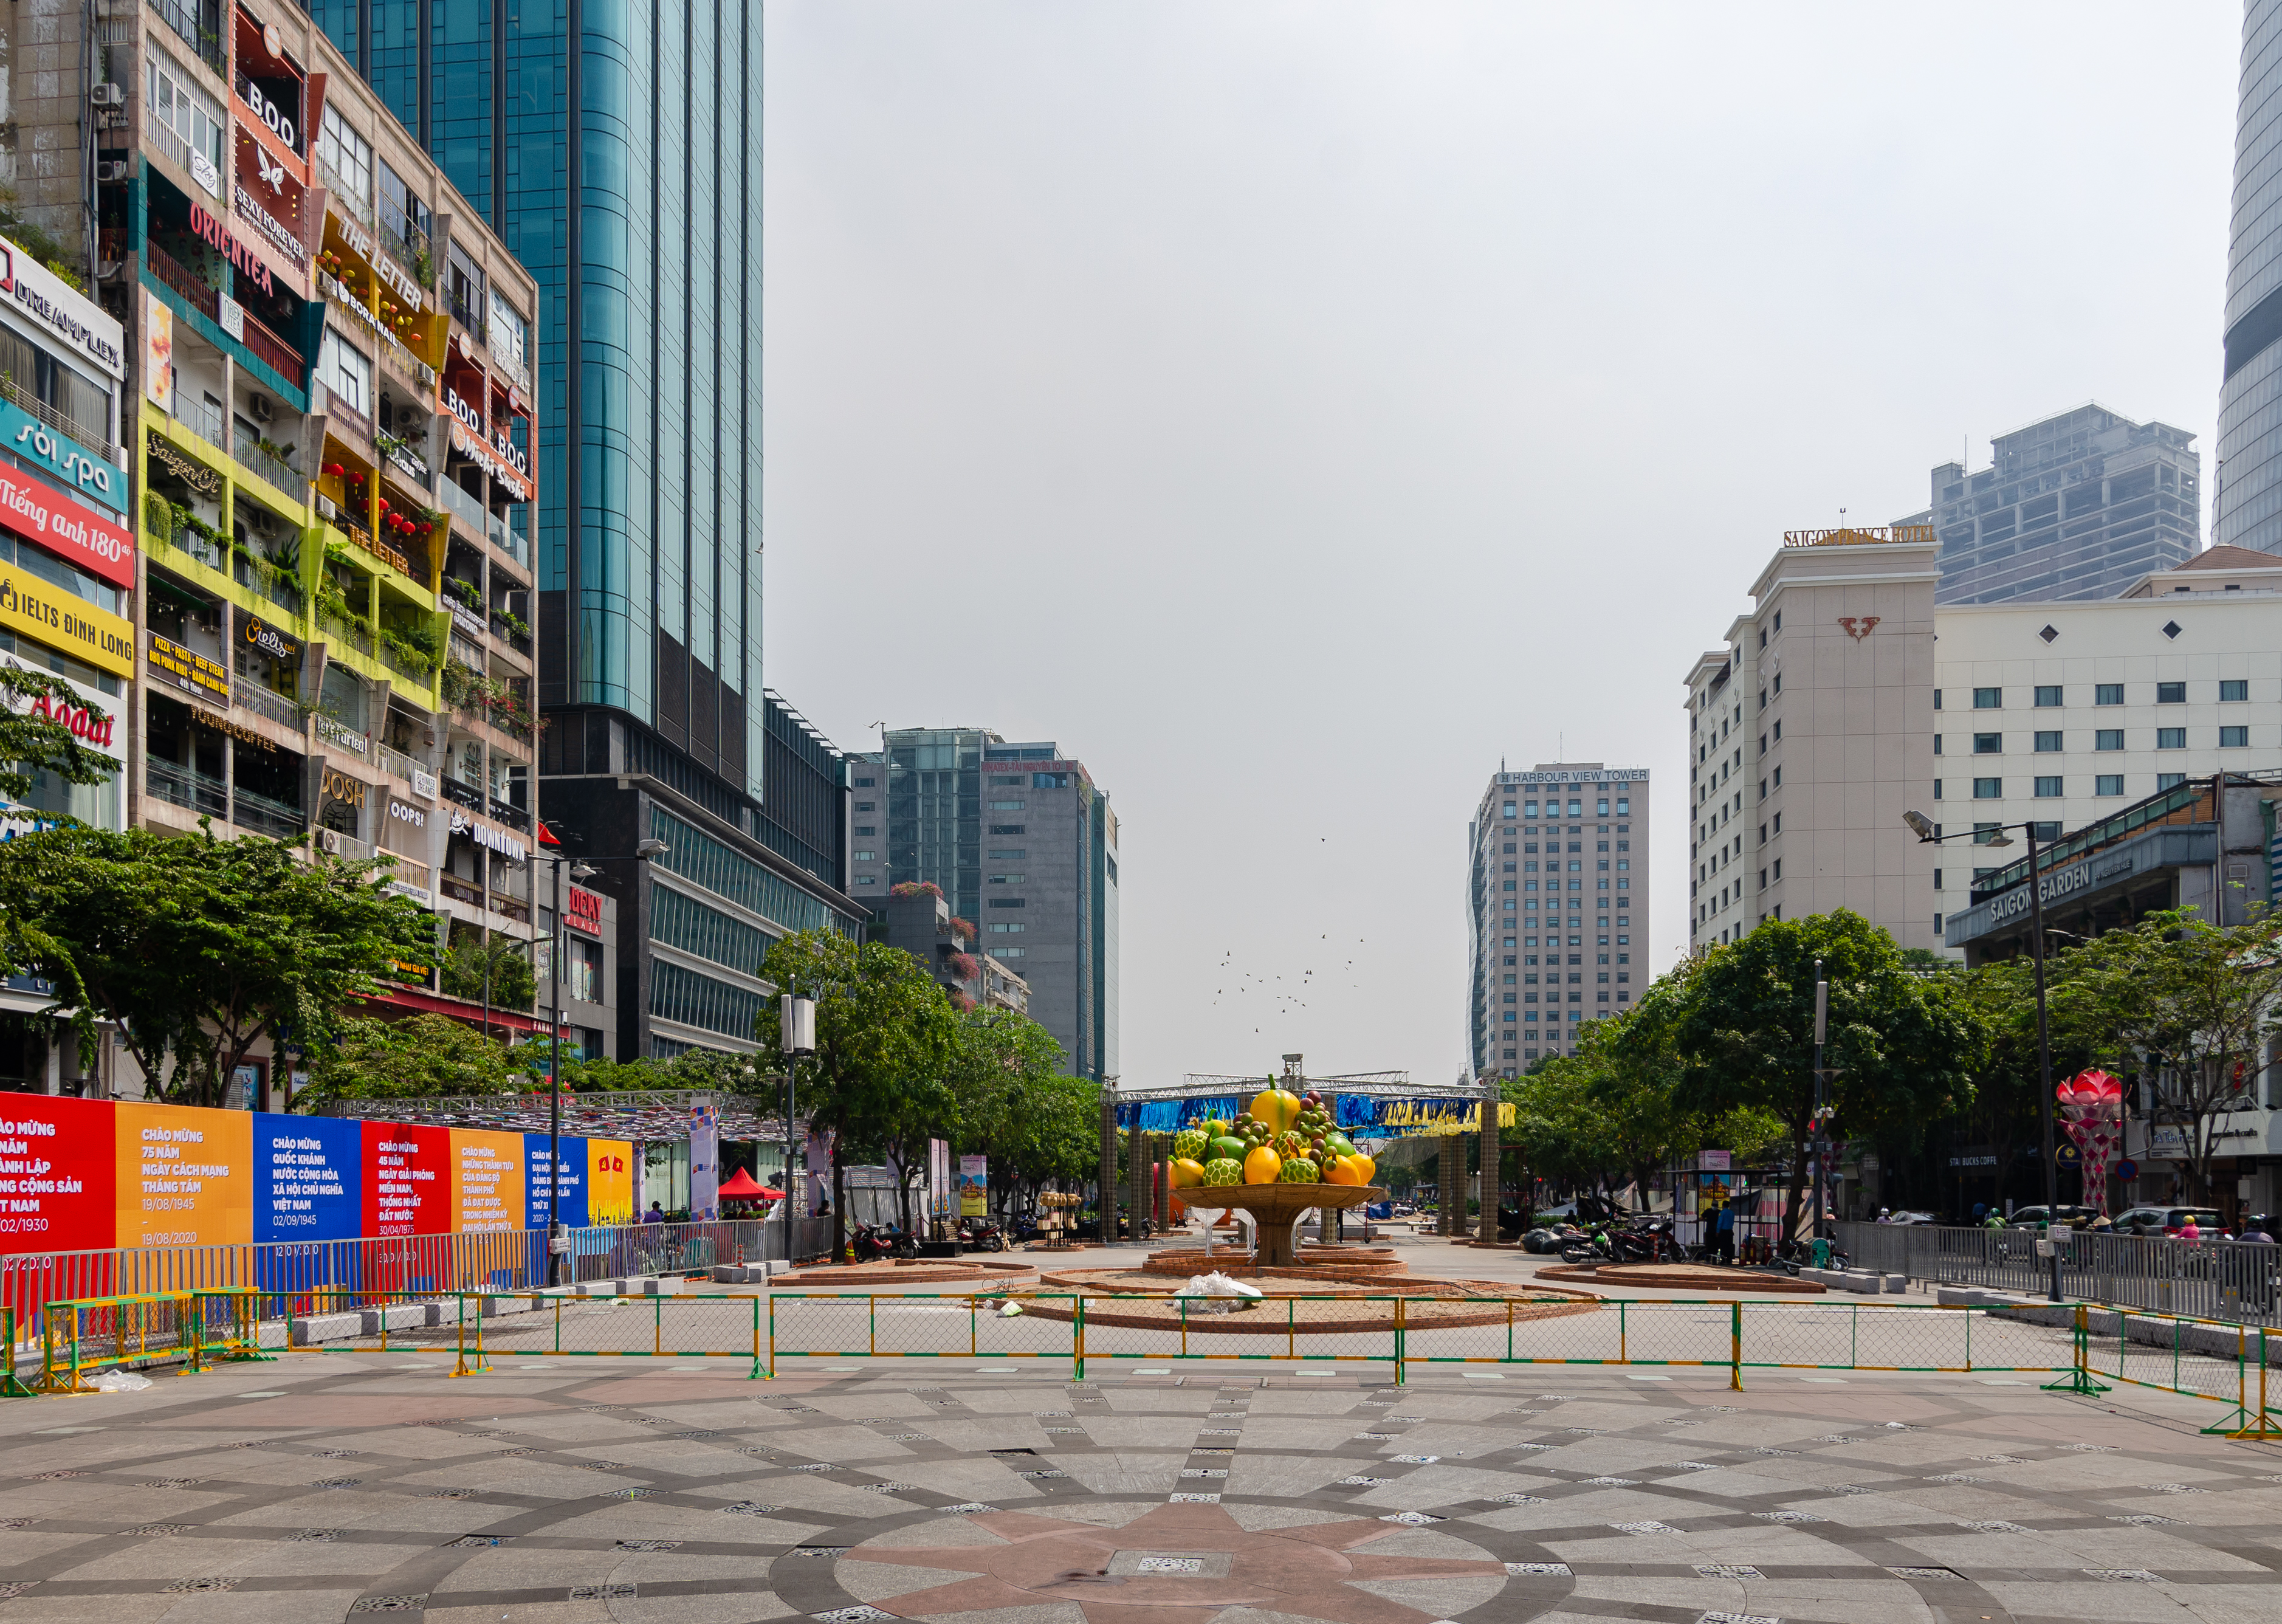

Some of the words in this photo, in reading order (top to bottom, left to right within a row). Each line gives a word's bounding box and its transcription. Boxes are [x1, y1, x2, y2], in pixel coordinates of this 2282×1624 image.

[250, 82, 294, 148] BOO
[194, 156, 216, 188] Sky
[236, 186, 262, 217] SEXY
[263, 210, 305, 261] FOREVER
[190, 202, 273, 297] ORIENTEA
[340, 214, 369, 263] THE
[371, 247, 422, 313] LETTER
[15, 279, 120, 368] DREAMPLEX
[350, 295, 376, 328] BORA
[377, 320, 397, 347] NAIL
[449, 388, 478, 432] BOO
[498, 433, 526, 474] BOO
[63, 452, 109, 492] spa
[465, 436, 494, 477] Michi
[497, 464, 524, 501] Sushi
[0, 478, 47, 531] Tiếng
[90, 528, 121, 563] 180
[1784, 529, 1834, 547] SAIGON
[1838, 528, 1888, 545] PRINCE
[1892, 525, 1937, 543] HOTEL
[348, 523, 371, 551] THE
[371, 538, 409, 577] LETTER
[22, 593, 58, 628] IELTS
[64, 613, 96, 645] ĐÌNH
[101, 630, 132, 661] LONG
[155, 636, 170, 653] PIZZA
[175, 646, 191, 663] PASTA
[196, 656, 208, 670] BEEF
[208, 662, 224, 678] STEAK
[149, 650, 160, 666] BBQ
[161, 655, 175, 672] PORK
[176, 662, 188, 677] RIBS
[192, 669, 205, 685] BÁNH
[206, 676, 219, 692] CANH
[179, 678, 189, 689] 4th
[190, 682, 202, 695] floor
[191, 704, 232, 735] YOUNG
[234, 724, 277, 752] COFFEE
[1051, 762, 1073, 771] TOER
[1513, 772, 1569, 782] HARBOUR
[1573, 771, 1601, 780] VIEW
[1605, 771, 1647, 780] TOWER
[391, 802, 424, 827] OOPS!
[1991, 890, 2032, 921] SAIGON
[2039, 863, 2089, 902] GARDEN
[569, 886, 602, 921] UCKY
[566, 915, 599, 935] PLAZA
[17, 1119, 55, 1136] MỪNG
[142, 1127, 171, 1142] CHÀO
[173, 1128, 204, 1143] MỪNG
[142, 1147, 154, 1158] 75
[156, 1144, 180, 1159] NĂM
[273, 1136, 296, 1149] CHÀO
[297, 1137, 321, 1151] MỪNG
[379, 1140, 397, 1152] CHÀO
[399, 1141, 419, 1153] MỪNG
[273, 1150, 297, 1165] QUỐC
[298, 1152, 326, 1165] KHÁNH
[379, 1156, 388, 1166] 45
[388, 1154, 404, 1166] NĂM
[462, 1146, 478, 1157] CHÀO
[479, 1147, 495, 1158] MỪNG
[532, 1149, 545, 1160] CHÀO
[26, 1158, 51, 1177] LẬP
[462, 1159, 483, 1169] NHỮNG
[484, 1160, 502, 1170] THÀNH
[1950, 1157, 1979, 1166] STABUCKS
[142, 1161, 171, 1176] NGÀY
[173, 1161, 201, 1177] CÁCH
[202, 1165, 229, 1179] MẠNG
[273, 1167, 297, 1180] NƯỚC
[298, 1167, 321, 1182] CỘNG
[322, 1168, 339, 1180] HÒA
[379, 1168, 397, 1180] NGÀY
[399, 1167, 412, 1180] GIẢI
[413, 1169, 435, 1180] PHÓNG
[462, 1171, 475, 1182] CỦA
[476, 1171, 492, 1182] ĐẢNG
[493, 1172, 500, 1184] BỘ
[19, 1177, 55, 1196] CỘNG
[57, 1175, 82, 1193] SẢN
[142, 1180, 179, 1193] THÁNG
[180, 1180, 202, 1193] TÁM
[570, 1174, 579, 1185] PHỐ
[273, 1182, 285, 1195] XÃ
[287, 1182, 301, 1197] HỘI
[302, 1181, 318, 1195] CHỦ
[320, 1183, 343, 1195] NGHĨA
[396, 1184, 413, 1195] NAM,
[462, 1185, 483, 1194] THÀNH
[483, 1183, 495, 1194] PHỐ
[10, 1199, 40, 1212] NAM
[142, 1199, 194, 1212] 19/08/1945
[273, 1197, 292, 1213] VIỆT
[293, 1200, 311, 1210] NAM
[379, 1194, 402, 1207] THỐNG
[403, 1194, 421, 1207] NHẤT
[533, 1200, 543, 1209] THỨ
[273, 1214, 317, 1227] 02/09/1945
[379, 1208, 394, 1221] ĐẤT
[394, 1209, 414, 1221] NƯỚC
[462, 1211, 482, 1219] TRONG
[379, 1224, 414, 1236] 30/04/1975
[142, 1232, 197, 1245] 19/08/2020
